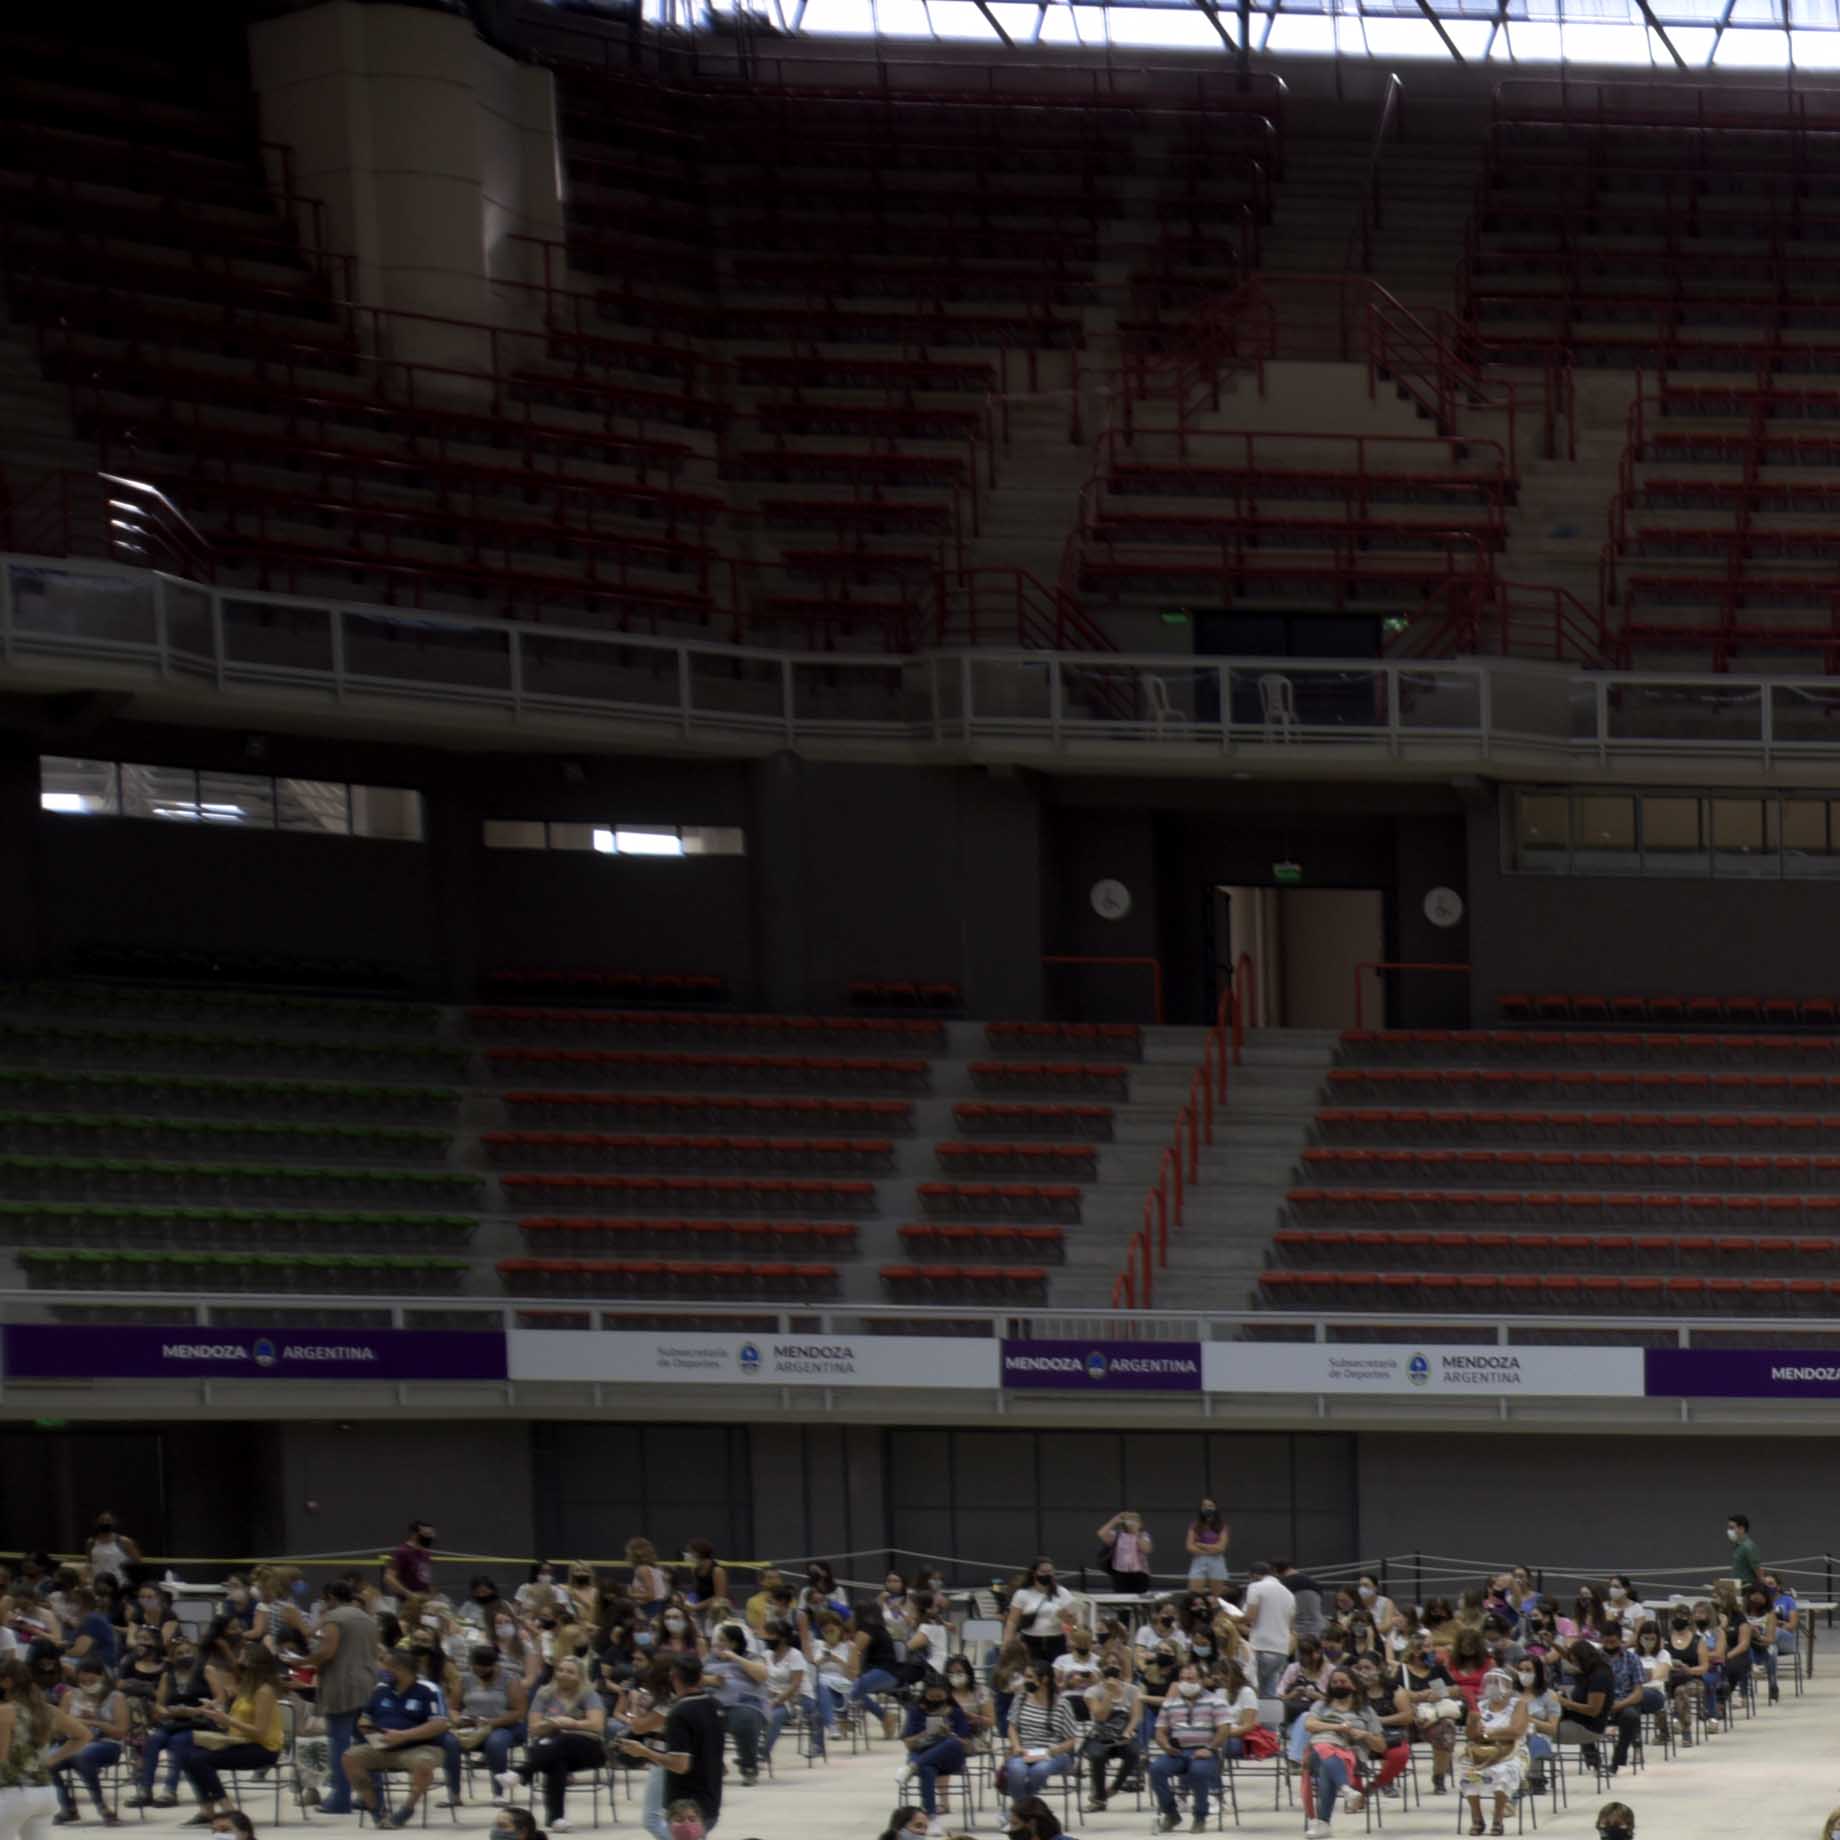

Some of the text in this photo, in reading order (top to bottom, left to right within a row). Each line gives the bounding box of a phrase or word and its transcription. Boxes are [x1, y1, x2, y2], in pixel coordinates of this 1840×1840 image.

[162, 1344, 374, 1361] MENDOZA ARGENTINA
[774, 1345, 854, 1359] MENDOZA
[775, 1360, 855, 1374] ARGENTINA
[1005, 1356, 1197, 1373] MENDOZA ARGENTINA
[1442, 1356, 1520, 1369] MENDOZA
[1443, 1370, 1521, 1384] ARGENTINA
